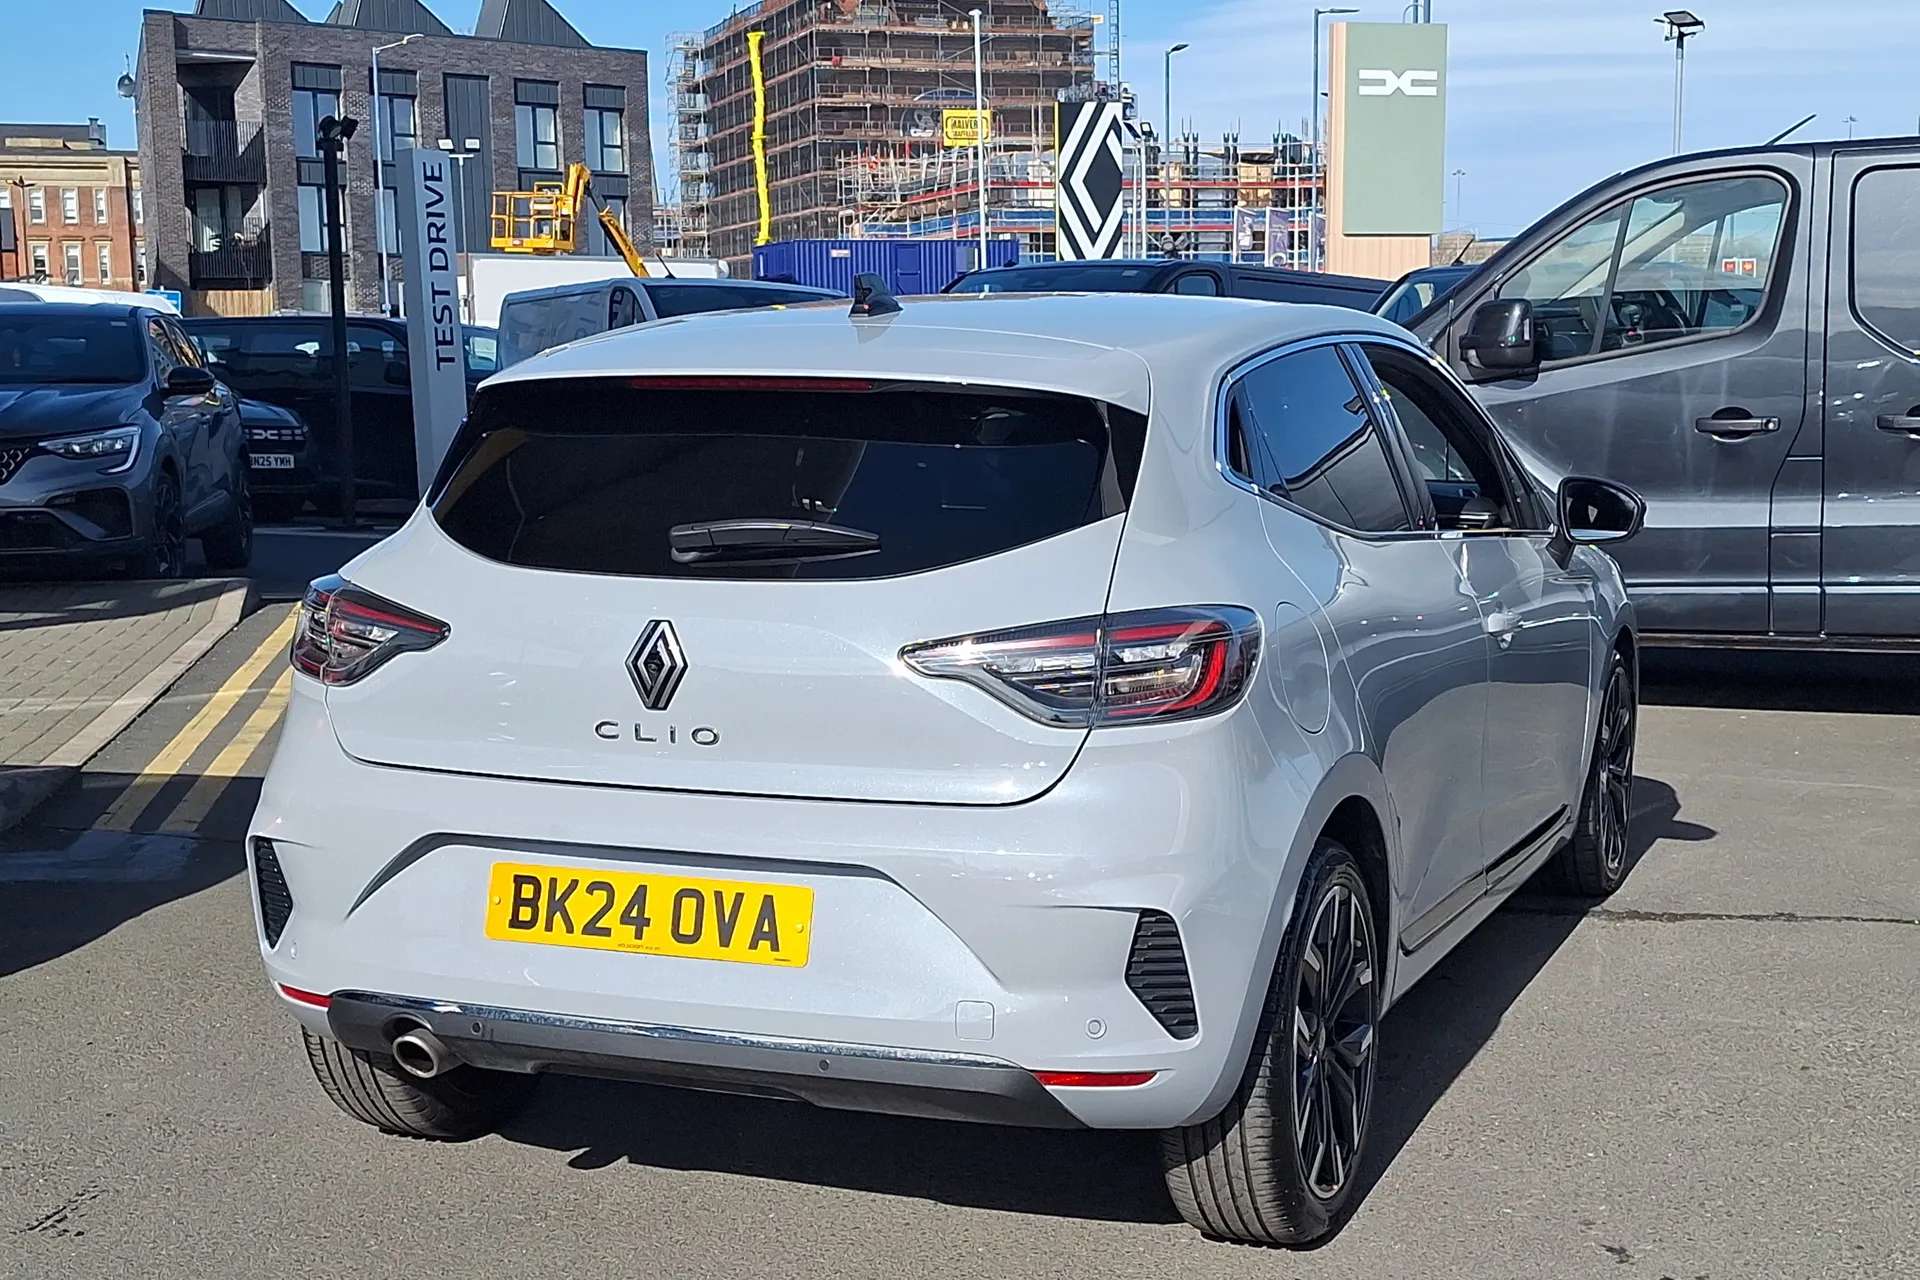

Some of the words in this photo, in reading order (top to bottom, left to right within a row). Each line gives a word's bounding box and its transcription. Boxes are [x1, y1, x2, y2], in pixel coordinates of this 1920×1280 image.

[422, 161, 449, 272] DRIVE
[431, 281, 456, 371] TEST
[594, 720, 720, 746] CLIO
[508, 874, 651, 940] BK24
[671, 888, 781, 952] OVA
